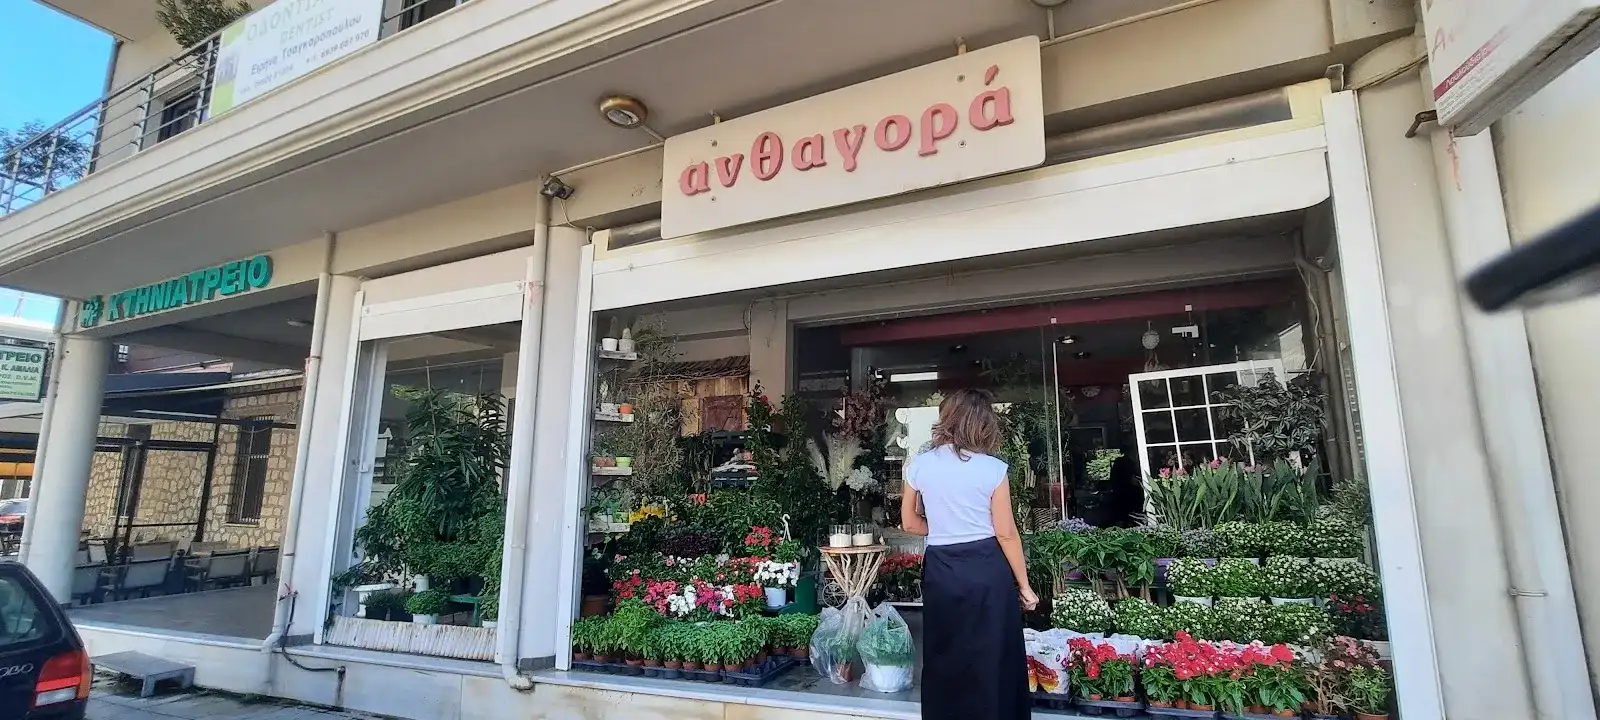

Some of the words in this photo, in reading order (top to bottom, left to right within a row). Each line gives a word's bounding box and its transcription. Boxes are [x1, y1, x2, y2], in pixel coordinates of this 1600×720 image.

[280, 7, 335, 43] DENTIST
[679, 63, 1015, 197] ανθαγορά
[107, 255, 272, 321] ΚΤΗΝΙΑΤΡΕΙΟ
